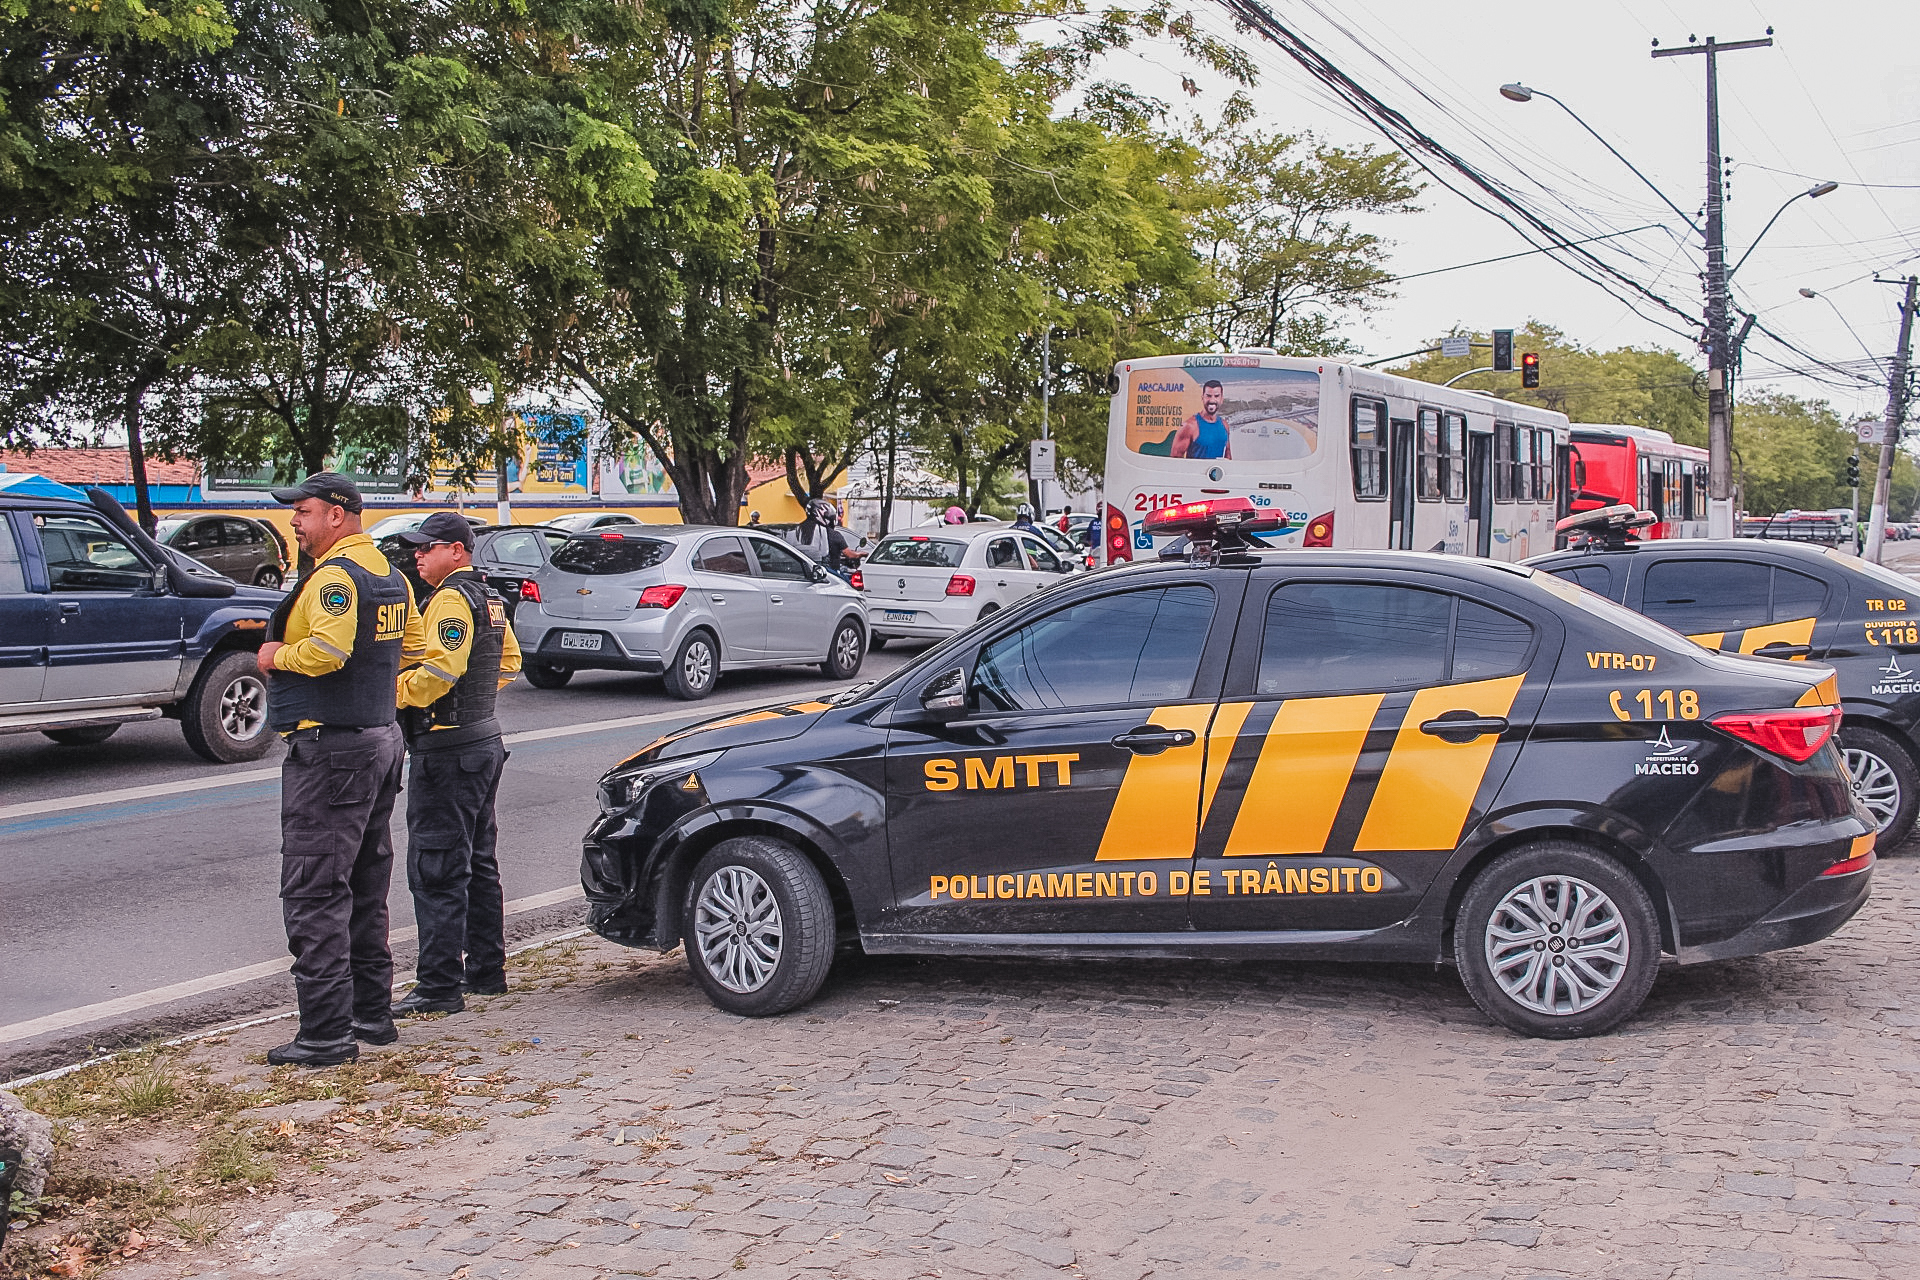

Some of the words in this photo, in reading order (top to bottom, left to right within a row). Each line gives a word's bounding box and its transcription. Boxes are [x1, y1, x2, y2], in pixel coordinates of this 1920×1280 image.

[1196, 357, 1221, 367] ROTA
[1137, 395, 1151, 404] DIAS
[1137, 404, 1182, 415] INESQUECÍVEIS
[1136, 416, 1144, 426] DE
[1145, 416, 1164, 426] PRAIA
[1165, 416, 1170, 426] E
[1172, 416, 1183, 426] SOL
[330, 492, 350, 503] SMTT
[1134, 493, 1183, 512] 2115
[1248, 494, 1271, 506] São
[1865, 600, 1884, 611] TR
[1888, 599, 1907, 611] 02
[377, 602, 406, 633] SMTT
[1864, 620, 1907, 628] OUVIDOR
[1881, 627, 1918, 645] 118
[1586, 651, 1657, 671] VTR-07
[1871, 681, 1920, 694] MACEIÓ
[1635, 689, 1700, 720] 118
[924, 752, 1080, 791] SMTT
[1634, 760, 1699, 775] MACEIÓ
[930, 870, 1157, 899] POLICIAMENTO
[1169, 870, 1211, 896] DE
[1221, 860, 1383, 894] TRÂNSITO
